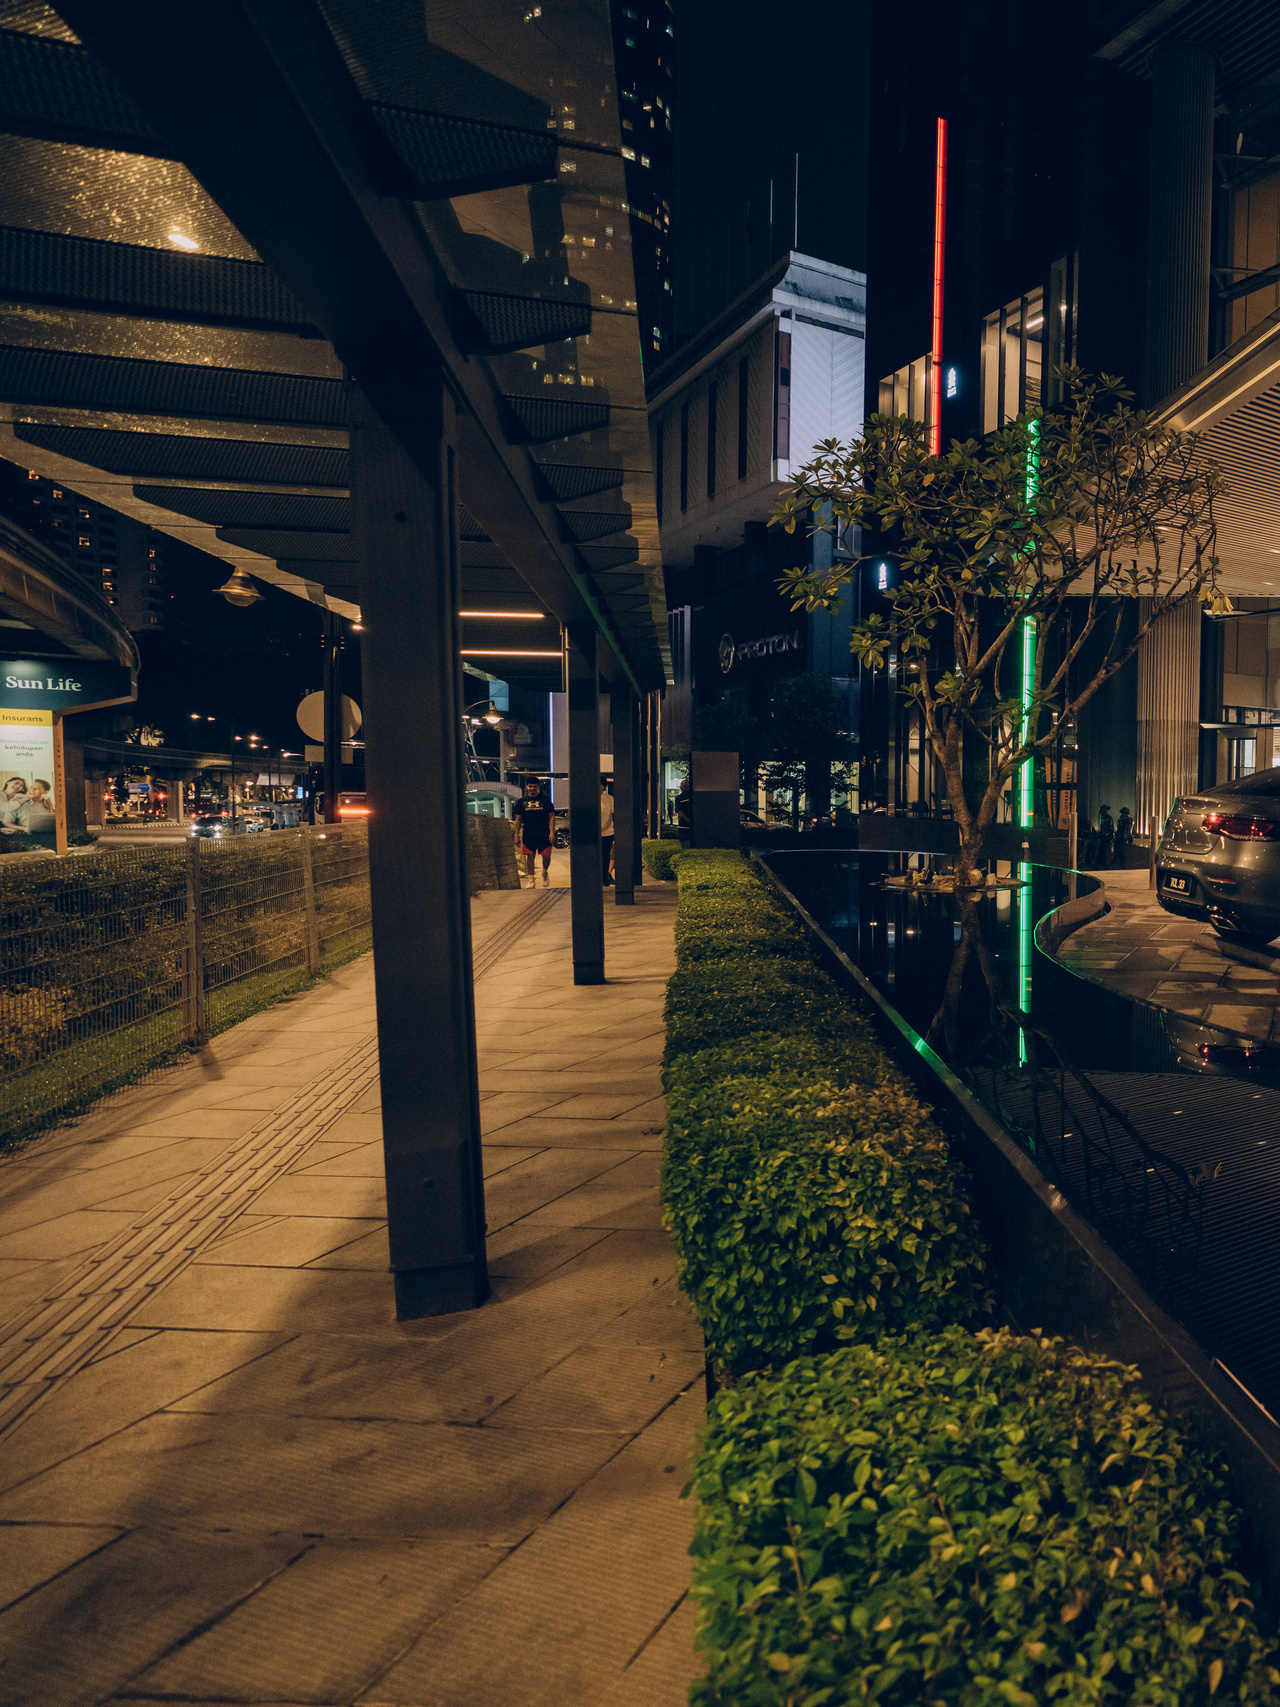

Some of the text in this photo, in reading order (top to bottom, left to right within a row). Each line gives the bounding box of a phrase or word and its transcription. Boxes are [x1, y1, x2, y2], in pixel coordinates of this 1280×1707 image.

[737, 630, 799, 660] PROTON
[5, 676, 82, 691] Sun Life
